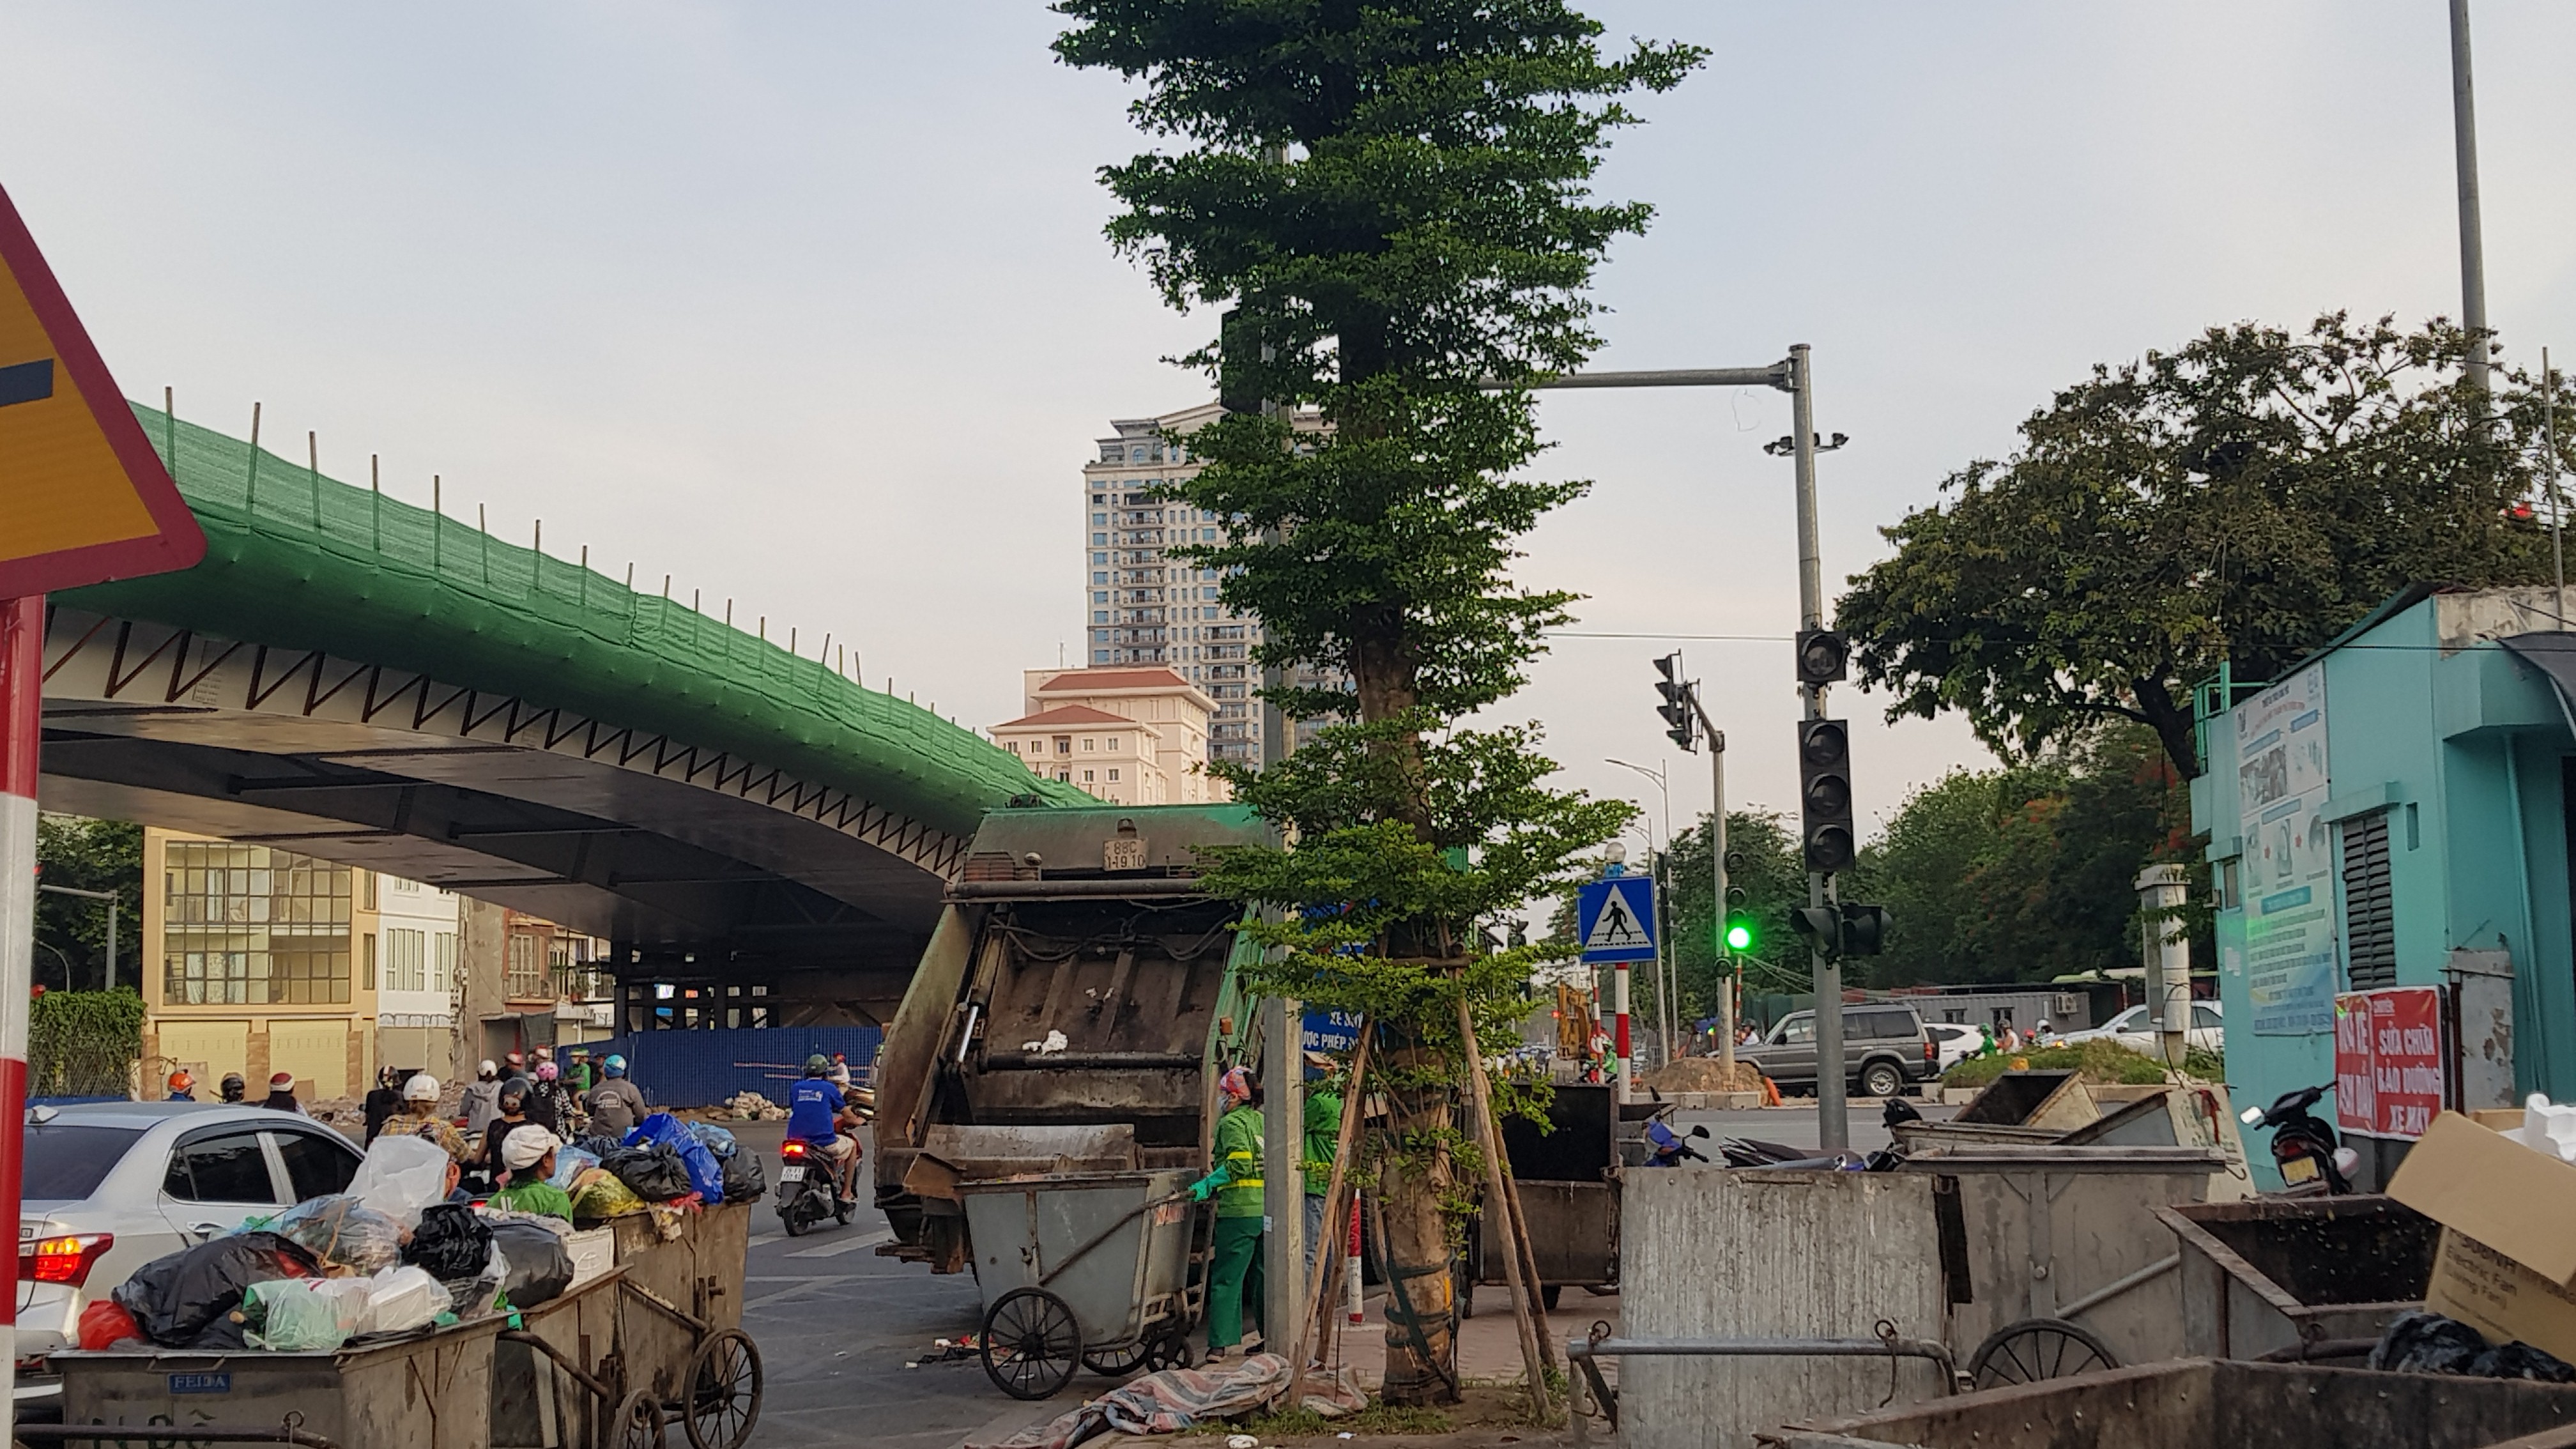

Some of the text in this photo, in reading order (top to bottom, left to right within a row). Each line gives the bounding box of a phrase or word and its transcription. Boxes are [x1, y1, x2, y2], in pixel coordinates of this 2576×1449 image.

[1114, 841, 1137, 855] 88C
[1321, 1032, 1346, 1050] PHÉP
[2379, 1020, 2403, 1055] SỬA
[2404, 1023, 2435, 1055] CHỮA
[2377, 1058, 2401, 1093] BẢO
[2403, 1061, 2441, 1094] DƯỠNG
[2389, 1101, 2430, 1132] XE MÁY
[2493, 1273, 2517, 1297] Fan
